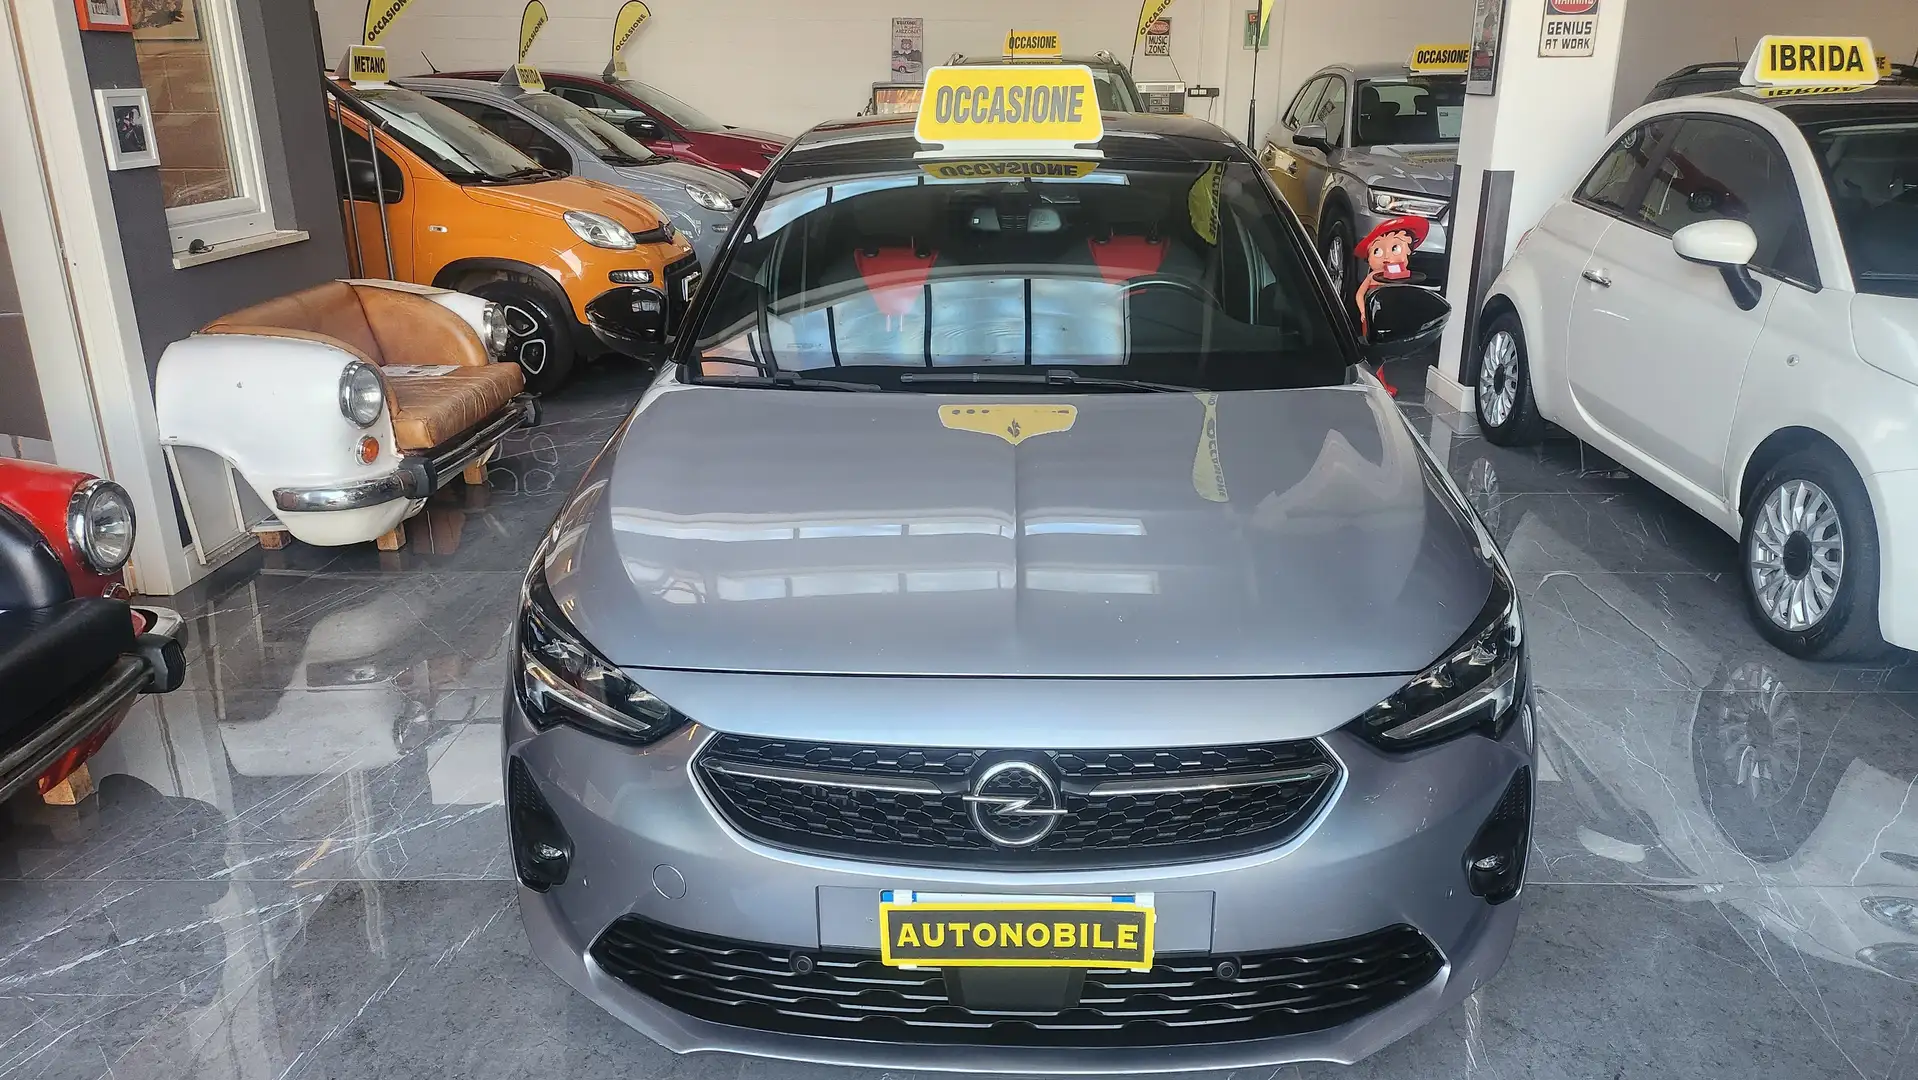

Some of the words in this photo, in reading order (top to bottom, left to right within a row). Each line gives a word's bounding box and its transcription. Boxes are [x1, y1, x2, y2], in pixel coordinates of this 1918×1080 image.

[615, 13, 647, 52] OCCASIONE
[1547, 21, 1593, 35] GENIUS
[521, 17, 545, 58] OCCASIONE
[1008, 36, 1057, 49] OCCASIONE
[1148, 35, 1168, 45] MUSIC
[1545, 38, 1559, 49] AT
[1561, 38, 1591, 49] WORK
[1148, 45, 1166, 54] ZONE
[1417, 50, 1470, 64] OCCASIONE
[354, 55, 386, 74] METANO
[1770, 44, 1864, 72] IBRIDA
[935, 85, 1085, 124] OCCASIONE
[896, 922, 1140, 951] AUTONOBILE
